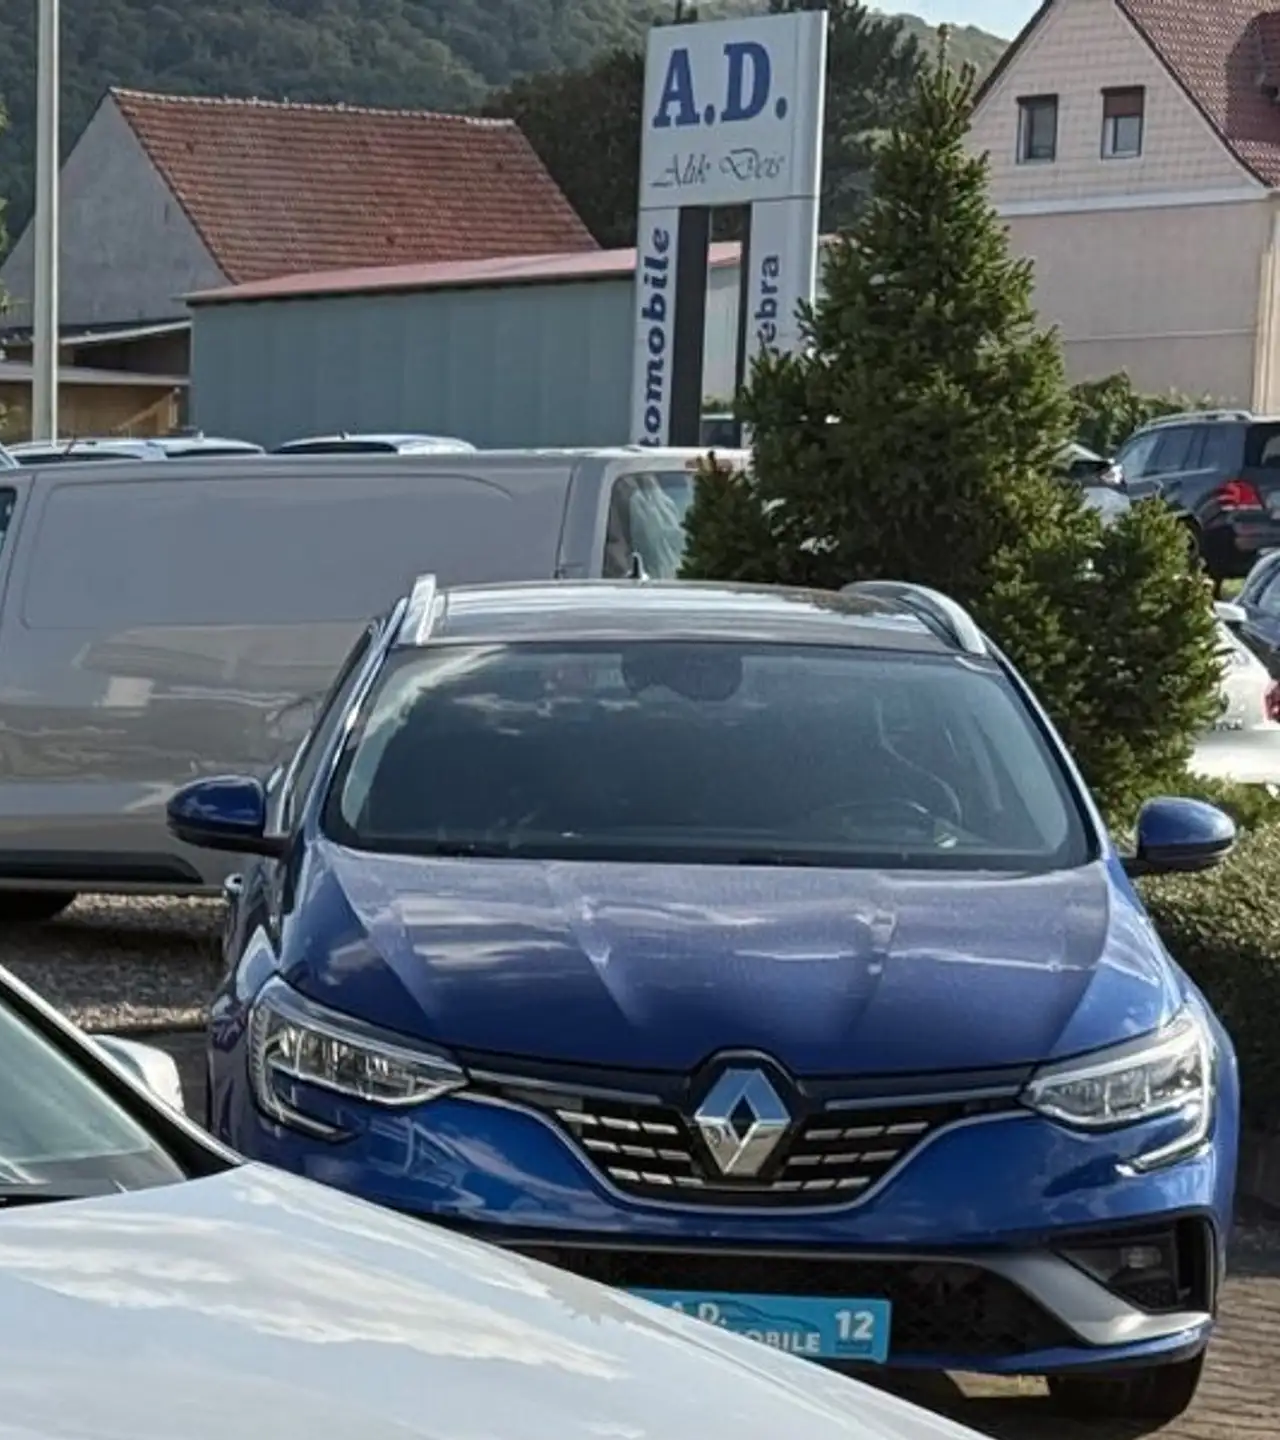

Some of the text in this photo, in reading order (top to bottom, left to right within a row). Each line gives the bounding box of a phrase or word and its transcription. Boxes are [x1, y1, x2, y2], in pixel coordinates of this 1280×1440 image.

[652, 41, 788, 129] A.D.
[754, 254, 780, 346] ebra
[737, 1331, 821, 1353] OBILE
[834, 1310, 875, 1341] 12
